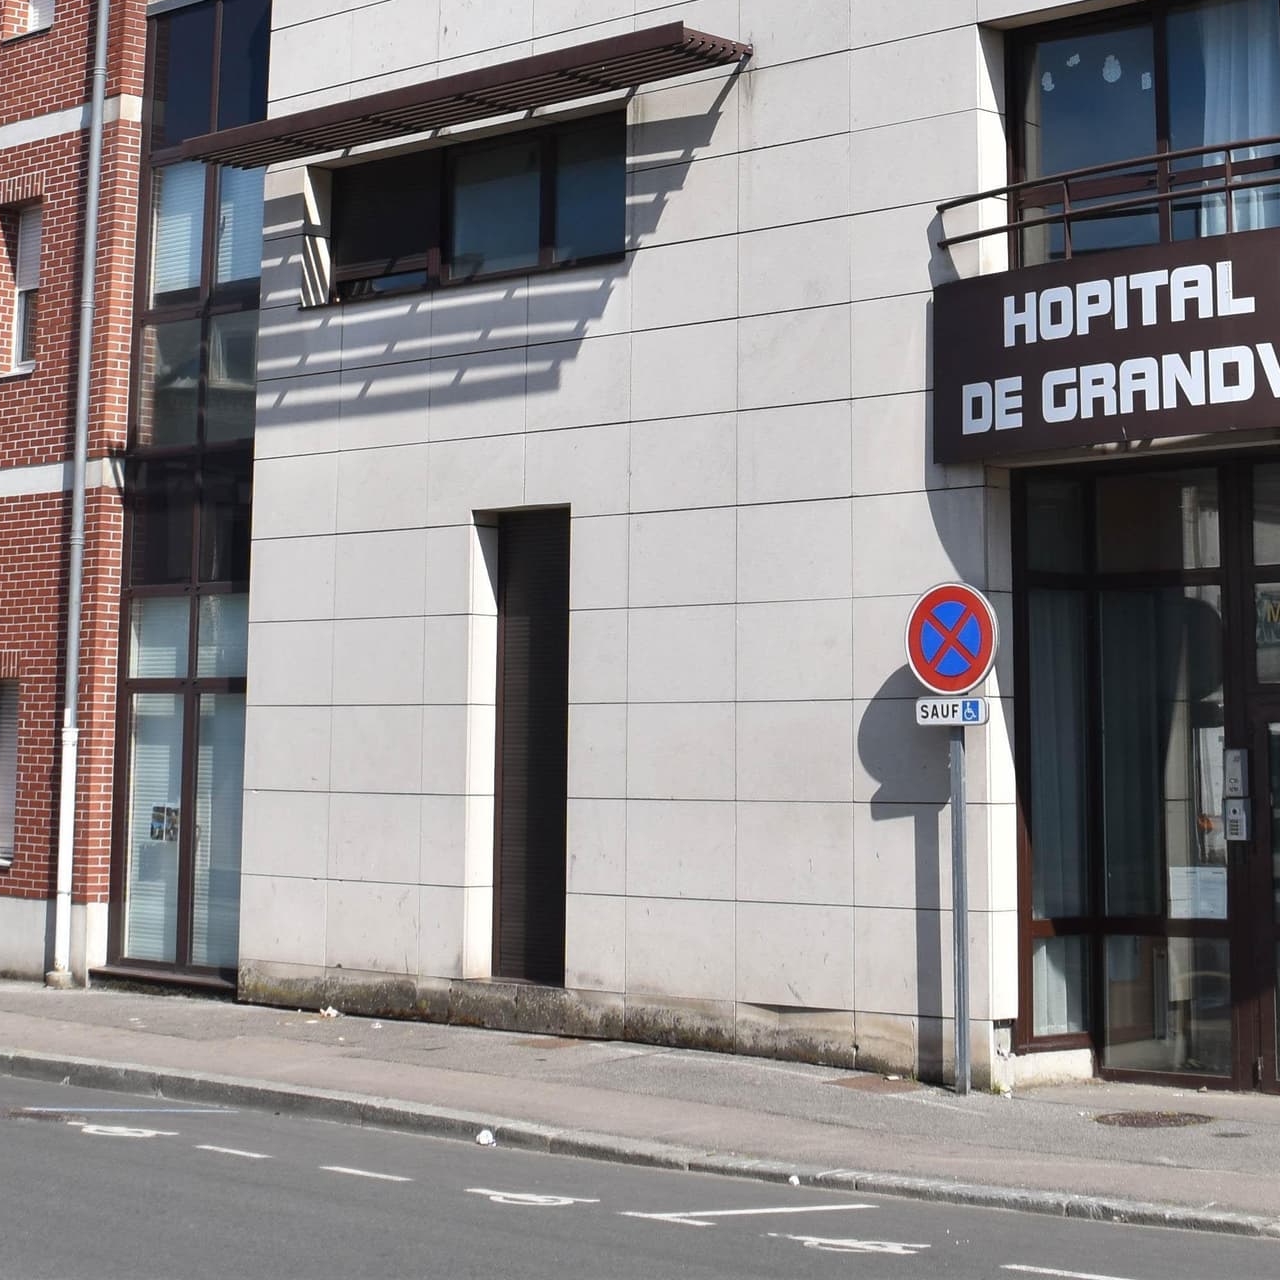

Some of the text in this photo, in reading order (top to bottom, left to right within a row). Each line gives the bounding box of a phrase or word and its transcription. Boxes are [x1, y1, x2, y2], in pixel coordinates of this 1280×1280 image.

[1002, 260, 1256, 348] HOPITAL
[961, 376, 1023, 435] DE
[920, 703, 959, 719] SAUF
